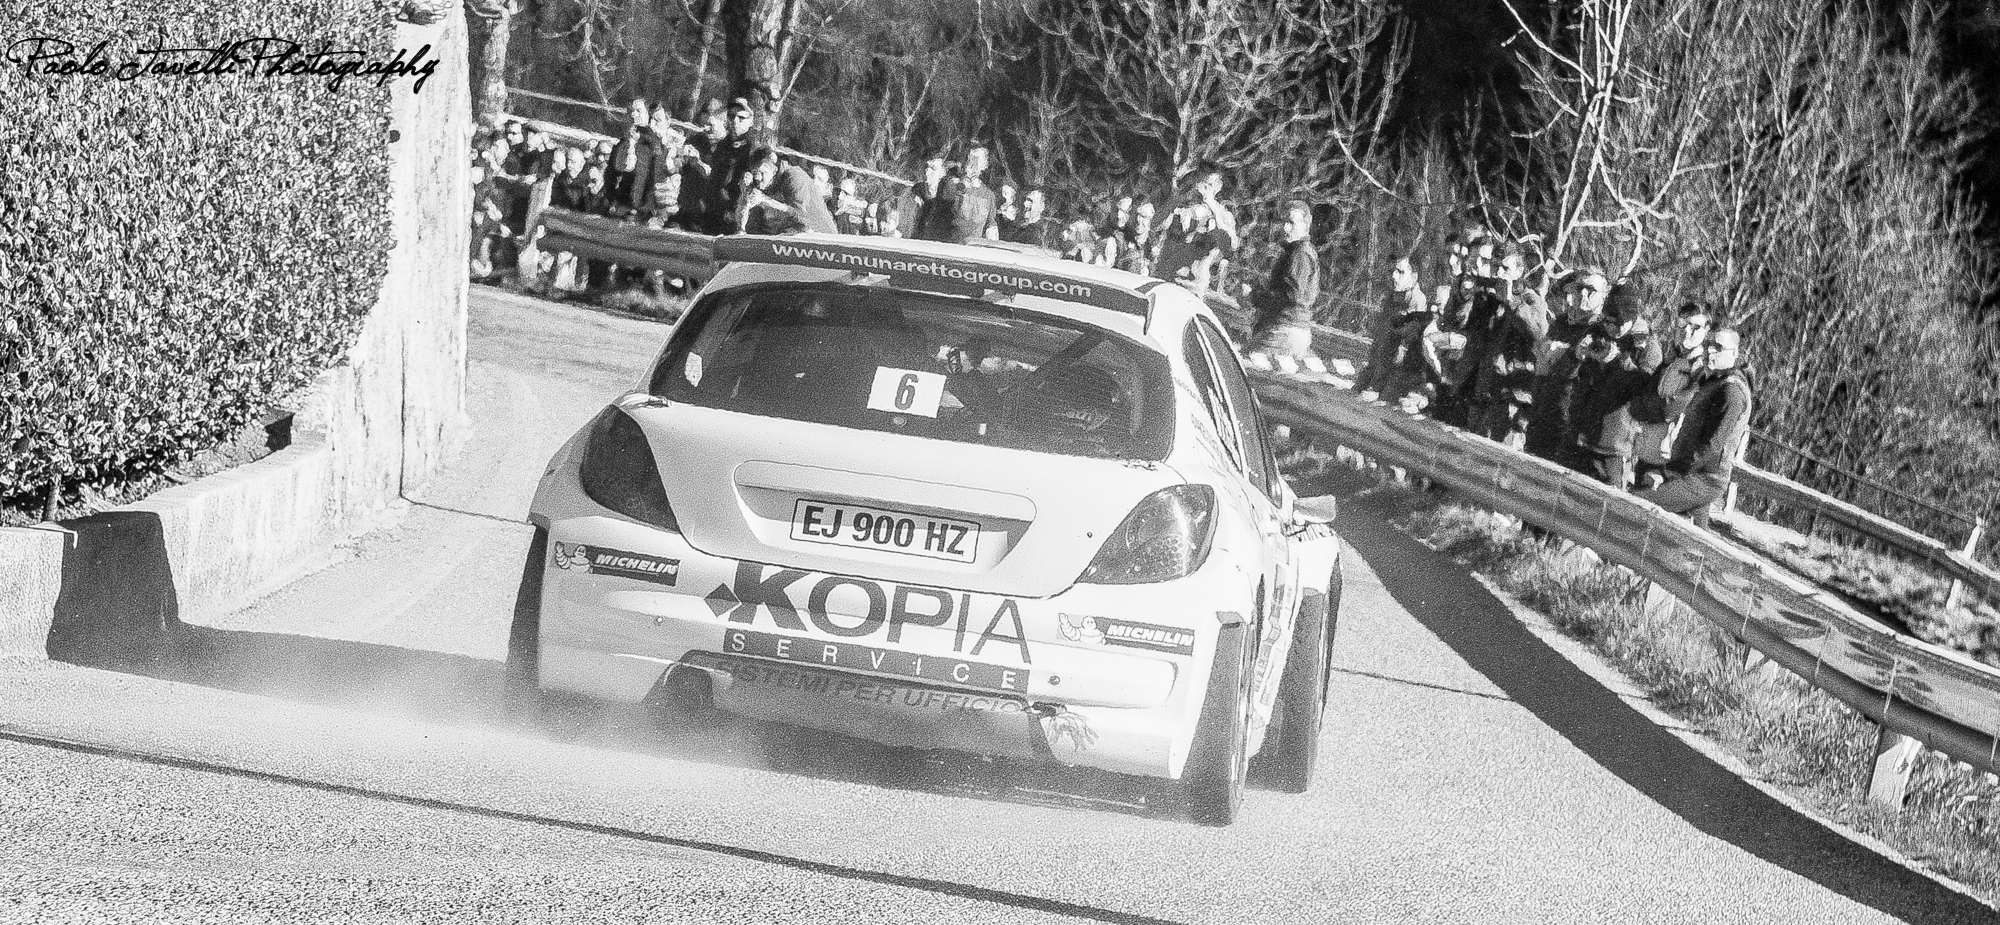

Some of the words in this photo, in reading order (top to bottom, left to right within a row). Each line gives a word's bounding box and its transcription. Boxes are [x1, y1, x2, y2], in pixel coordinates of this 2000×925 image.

[772, 243, 1092, 298] www.munarettogroup.com
[894, 373, 919, 410] 6
[802, 505, 844, 538] EJ
[852, 512, 916, 548] 900
[924, 521, 969, 556] HZ
[596, 553, 679, 576] MICHELIN
[728, 560, 1032, 665] KOPIA
[1106, 623, 1195, 647] MICHELIN
[731, 632, 1017, 690] SERVICE
[834, 678, 897, 704] PER
